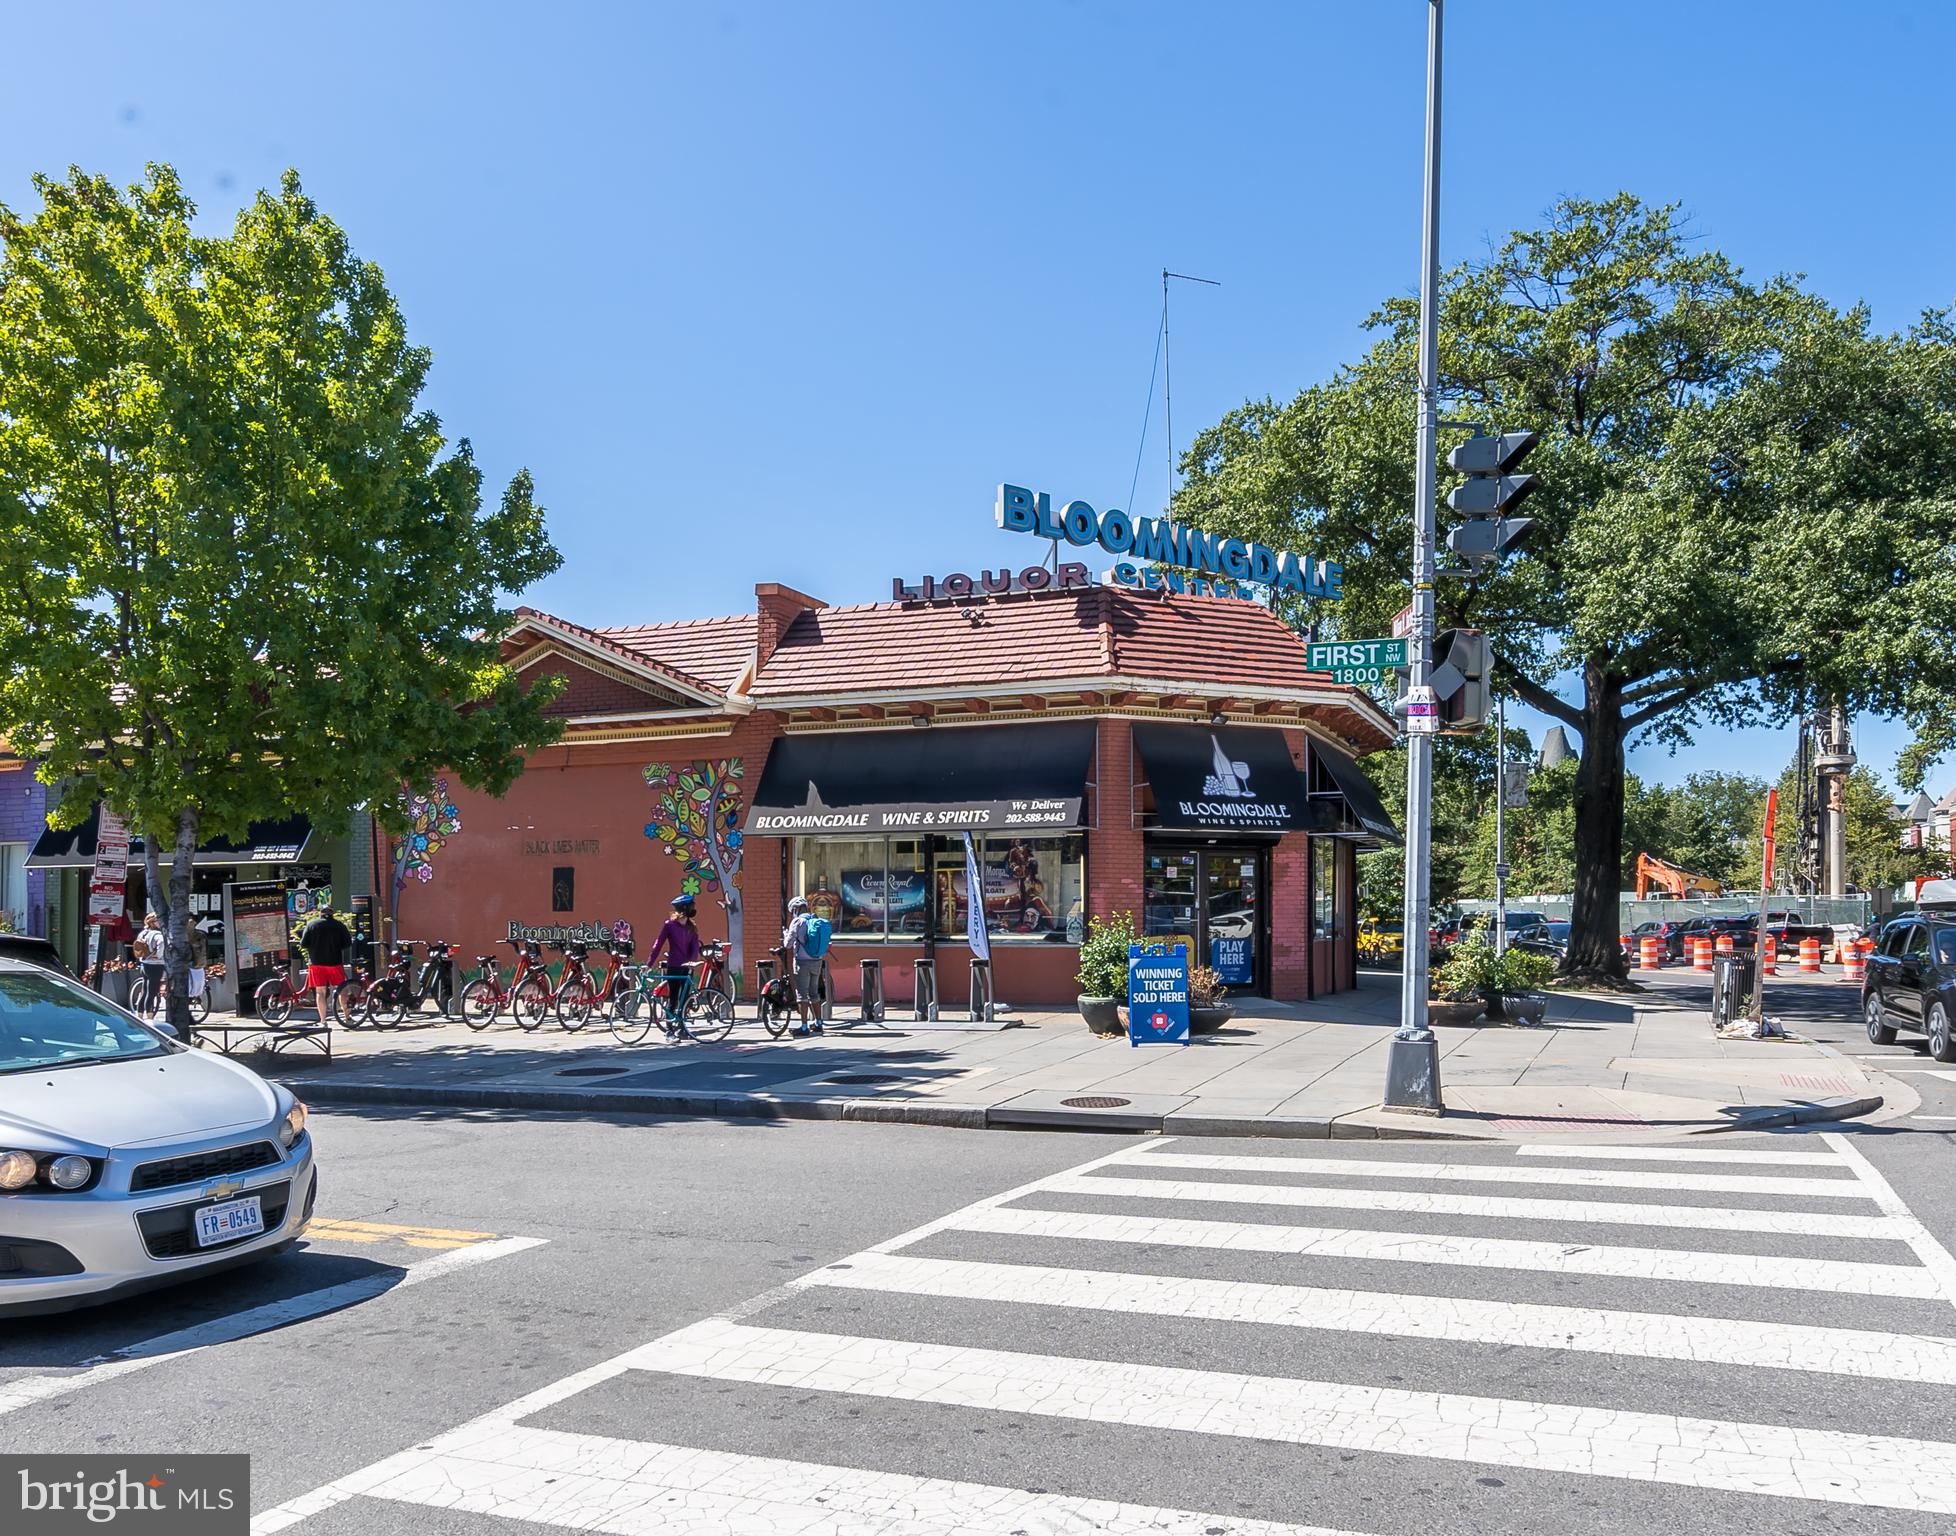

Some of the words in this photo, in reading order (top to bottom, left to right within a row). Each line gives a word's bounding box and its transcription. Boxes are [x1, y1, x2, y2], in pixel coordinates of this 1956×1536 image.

[998, 483, 1344, 600] BLOOMINGDALE
[893, 562, 1089, 600] LIQUOR
[1312, 644, 1380, 667] FIRST
[1386, 643, 1400, 653] ST
[1385, 652, 1401, 662] NW
[1334, 667, 1379, 683] 1800
[1012, 801, 1027, 810] We
[1030, 800, 1065, 810] Deliver
[1179, 801, 1291, 818] BLOOMINGDALE
[755, 813, 869, 829] BLOOMINGDALE
[882, 812, 920, 826] WINE
[922, 812, 935, 825] &
[937, 810, 990, 824] SPIRITS
[1005, 812, 1066, 824] 202-588-9443
[525, 840, 550, 854] BLACK
[553, 840, 573, 854] LIVES
[888, 874, 914, 890] Royal
[1219, 941, 1245, 953] PLAY
[1219, 953, 1245, 965] HERE
[1135, 968, 1183, 979] WINNING
[1143, 980, 1175, 991] TICKET
[1132, 992, 1158, 1003] SOLD
[1160, 991, 1186, 1003] HERE!
[202, 1215, 220, 1235] FR
[229, 1207, 257, 1229] 0549
